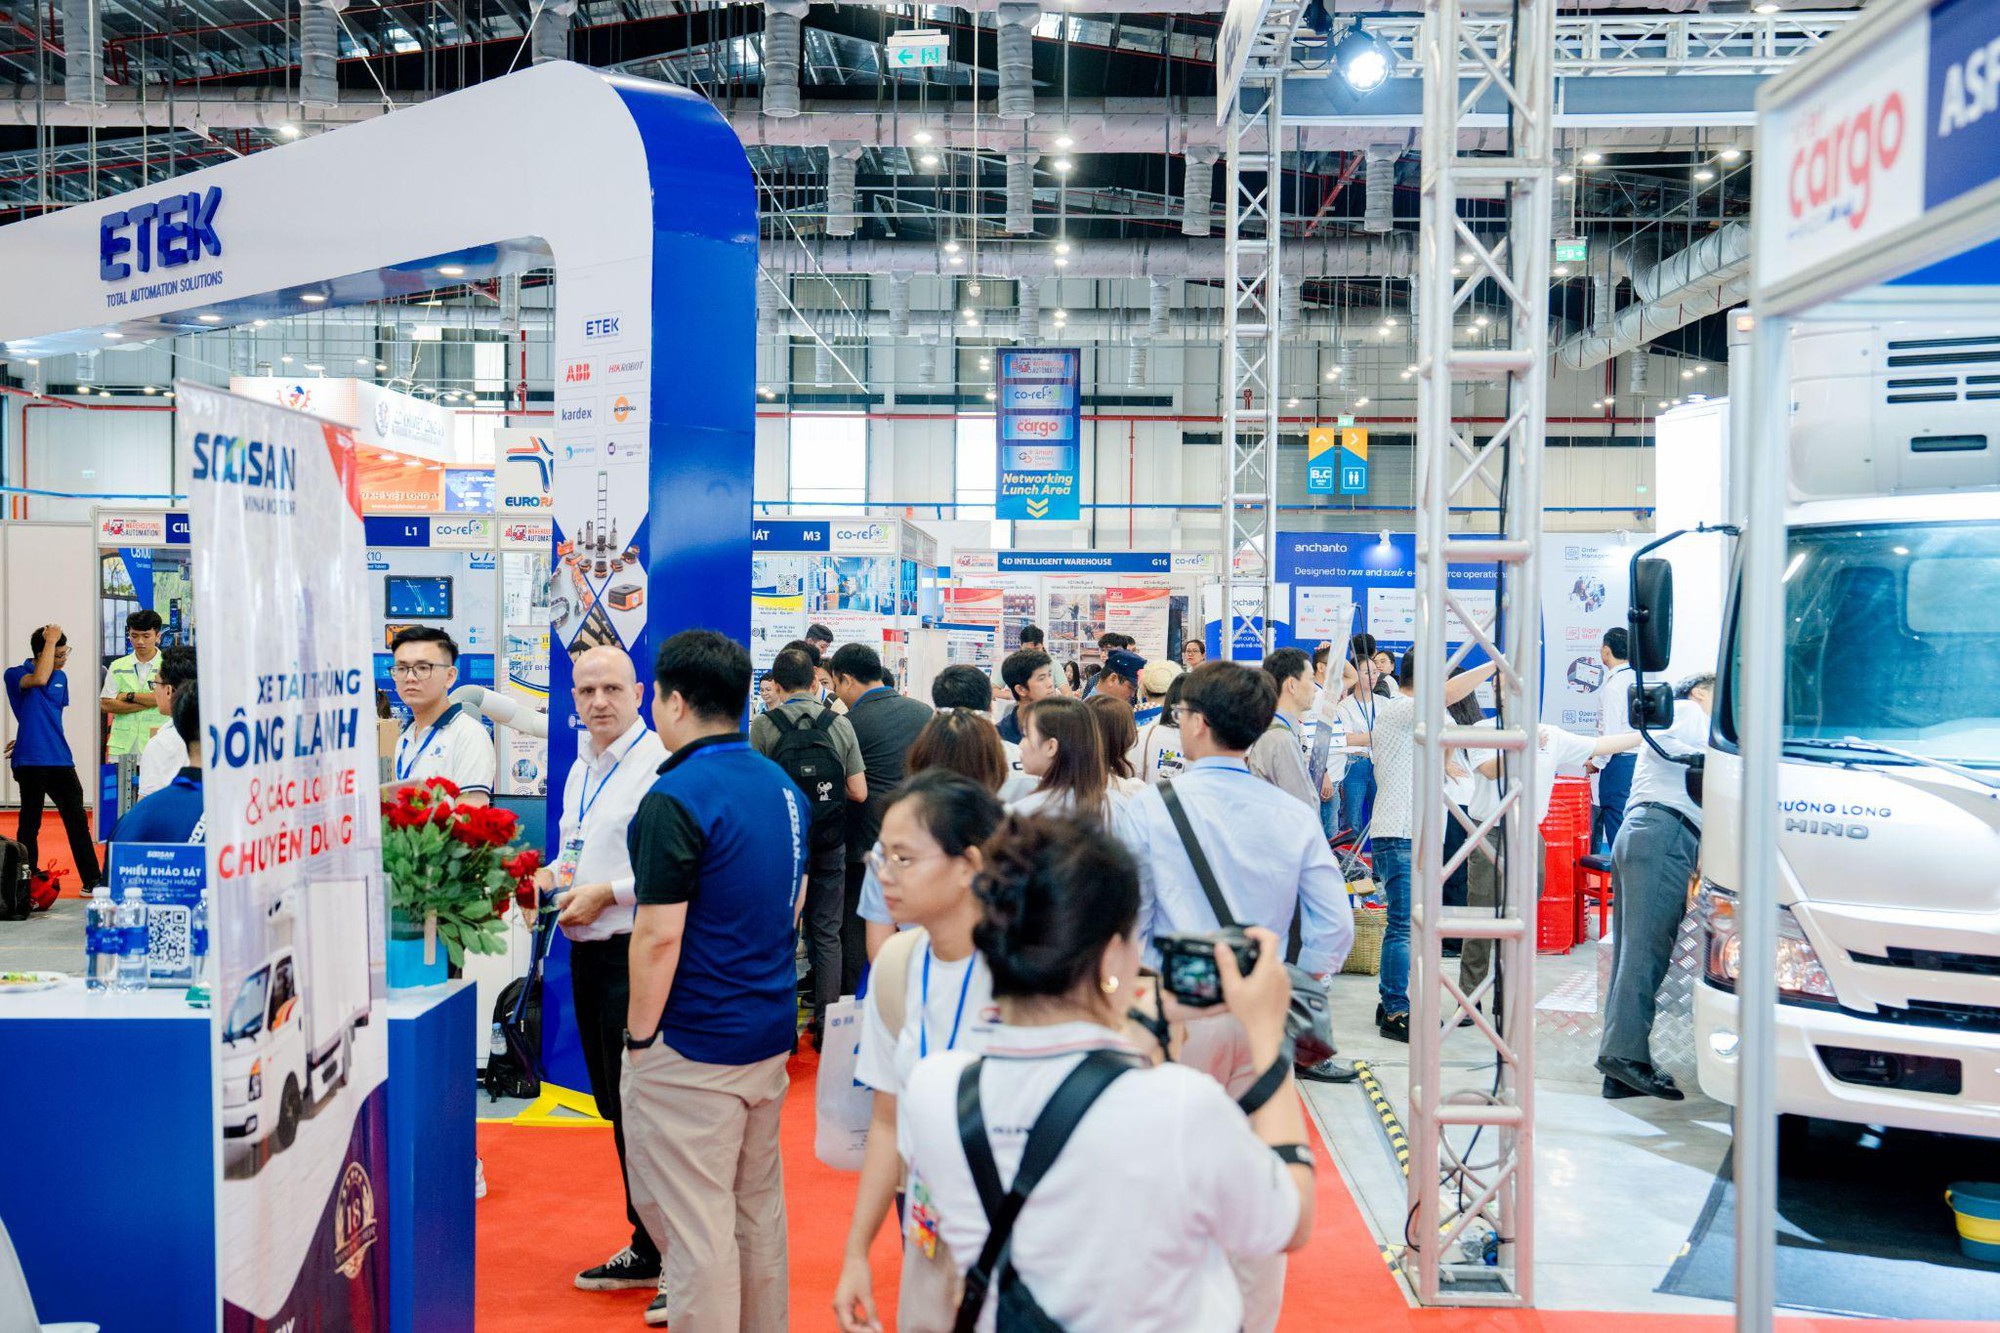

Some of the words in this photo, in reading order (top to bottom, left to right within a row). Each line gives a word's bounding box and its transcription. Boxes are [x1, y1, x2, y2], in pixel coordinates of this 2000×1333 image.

[1788, 90, 1905, 231] cargo
[101, 185, 223, 281] ETEK
[106, 291, 129, 308] TOTAL
[130, 280, 179, 303] AUTOMATION
[180, 270, 223, 293] SOLUTIONS
[586, 317, 619, 336] ETEK
[566, 362, 591, 382] ABB
[608, 360, 644, 374] HIKROBOT
[561, 408, 592, 421] kardex
[1017, 420, 1059, 437] cargo
[1002, 473, 1073, 486] Networking
[1002, 484, 1039, 495] Lunch
[1041, 484, 1071, 495] Area
[404, 526, 419, 536] L1
[803, 530, 821, 541] M3
[1295, 543, 1347, 553] anchanto
[1014, 558, 1062, 566] INTELLIGENT
[1063, 558, 1112, 566] WAREHOUSE
[1151, 558, 1168, 566] G16
[1294, 566, 1335, 577] Designed
[1337, 567, 1346, 576] to
[1382, 567, 1405, 577] scale
[1233, 598, 1263, 607] nchant
[257, 674, 273, 704] XE
[246, 777, 263, 825] &
[267, 774, 296, 813] CÁC
[1842, 804, 1892, 818] LONG
[1785, 818, 1869, 840] HINO
[218, 821, 303, 880] CHUYÊN
[119, 863, 148, 876] PHIẾU
[150, 865, 180, 877] KHẢO
[182, 866, 202, 878] SÁT
